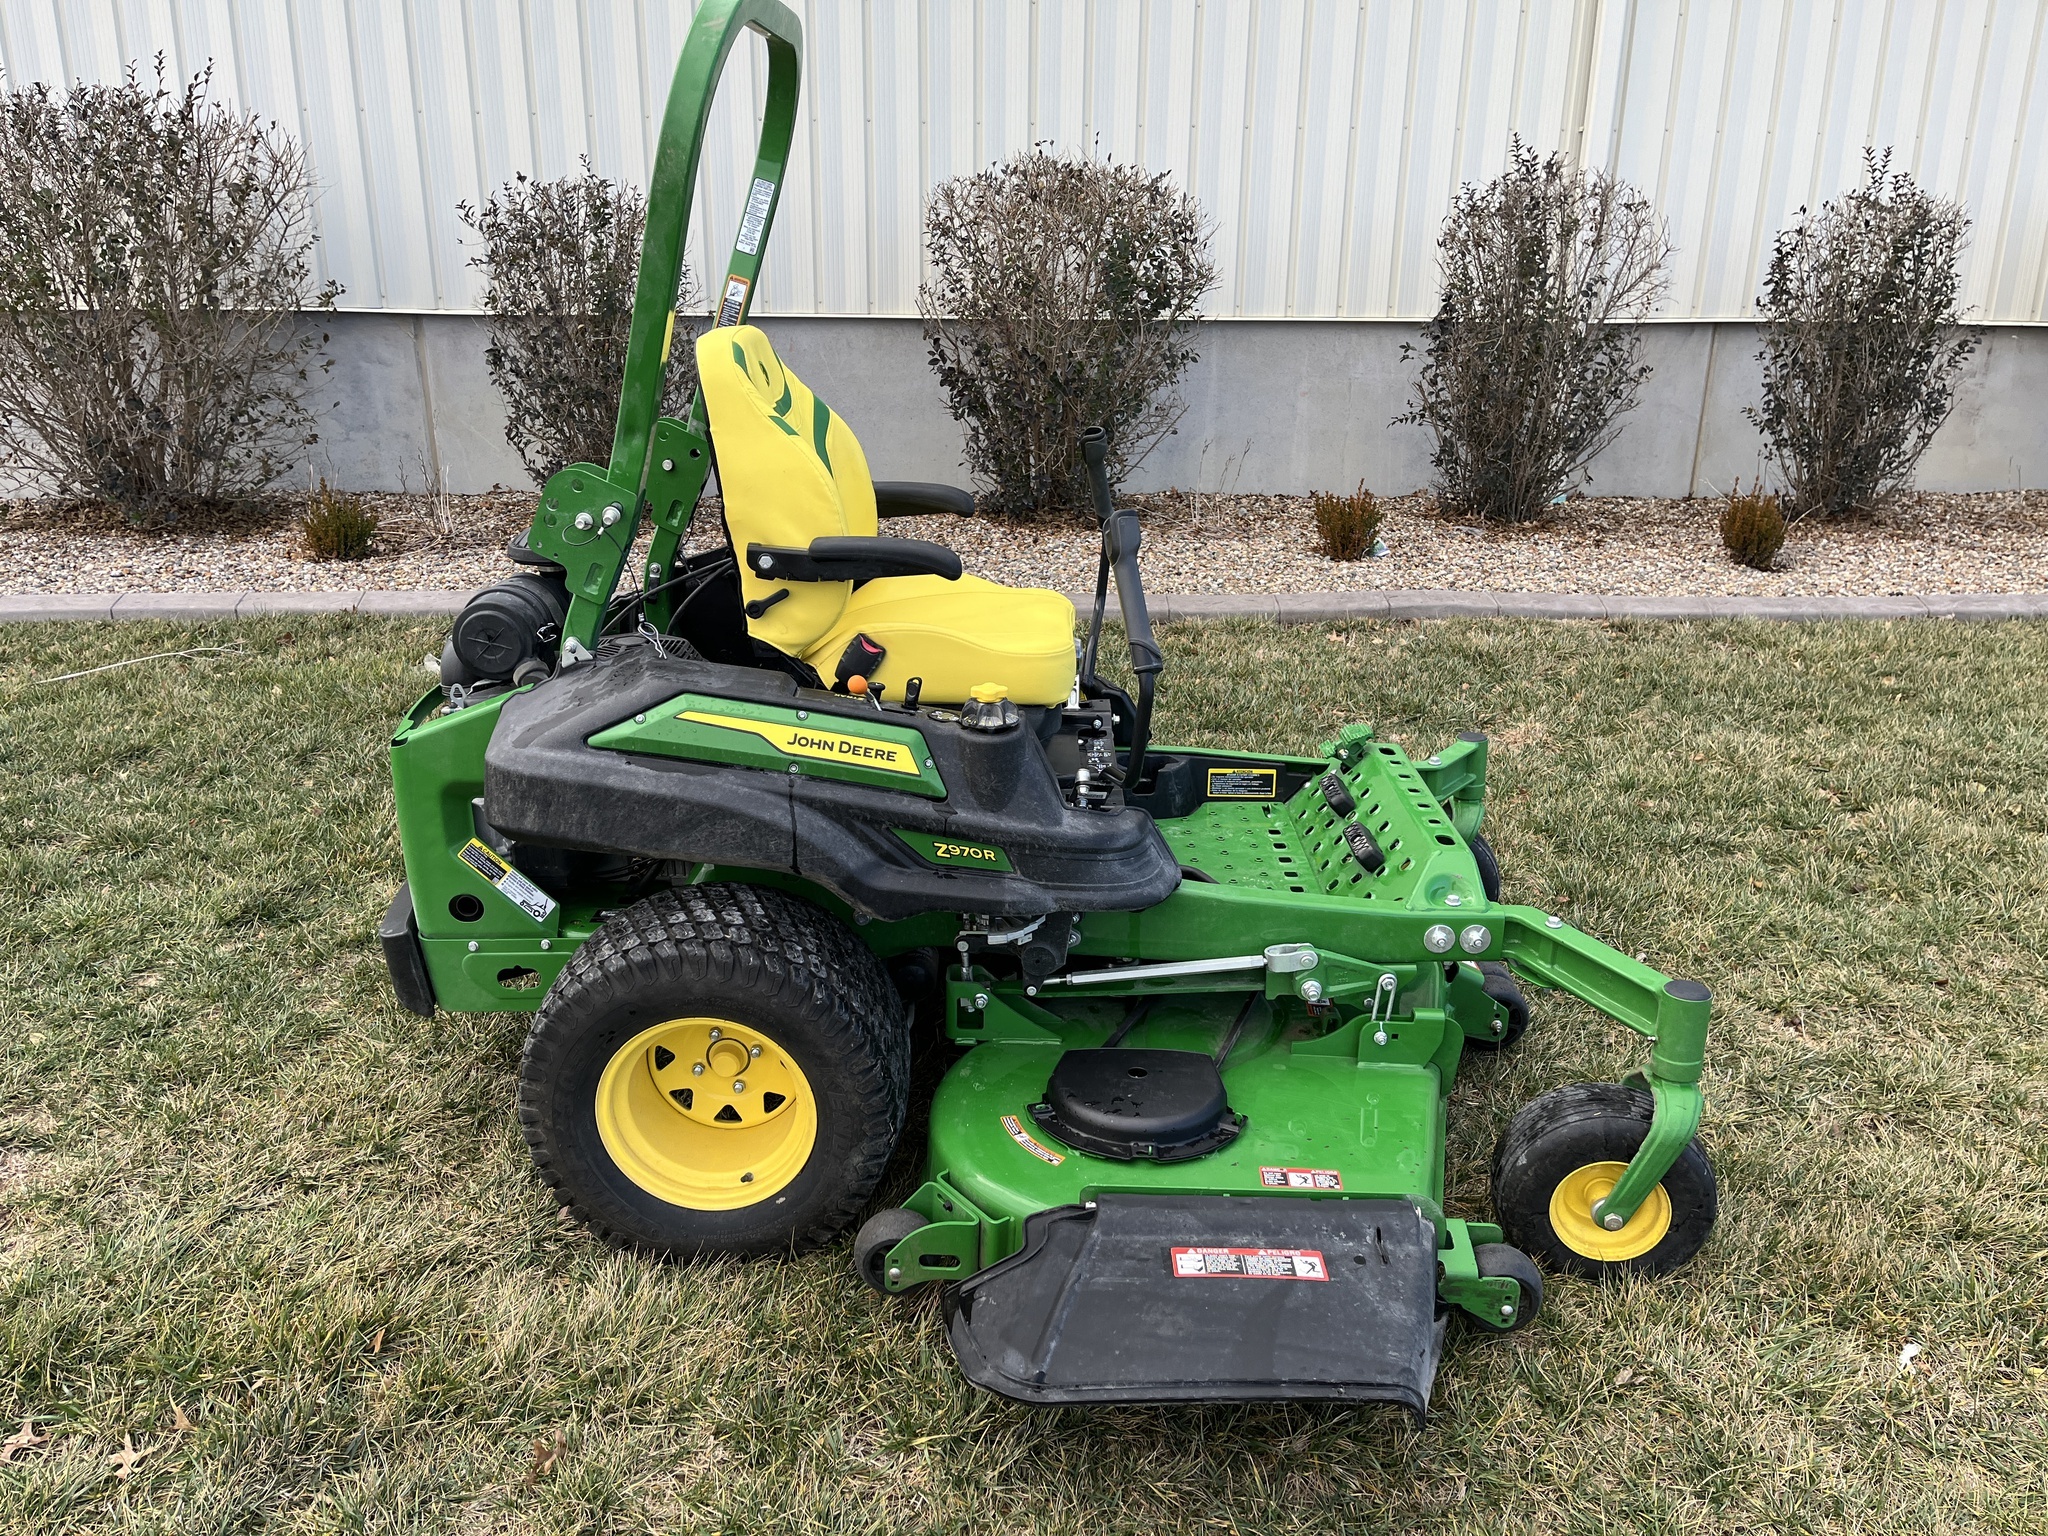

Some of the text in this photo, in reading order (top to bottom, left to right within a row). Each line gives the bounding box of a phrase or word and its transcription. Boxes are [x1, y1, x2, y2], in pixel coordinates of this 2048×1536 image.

[787, 733, 897, 762] JOHN DEERE
[482, 848, 502, 865] CAUTION
[933, 842, 997, 862] Z970R
